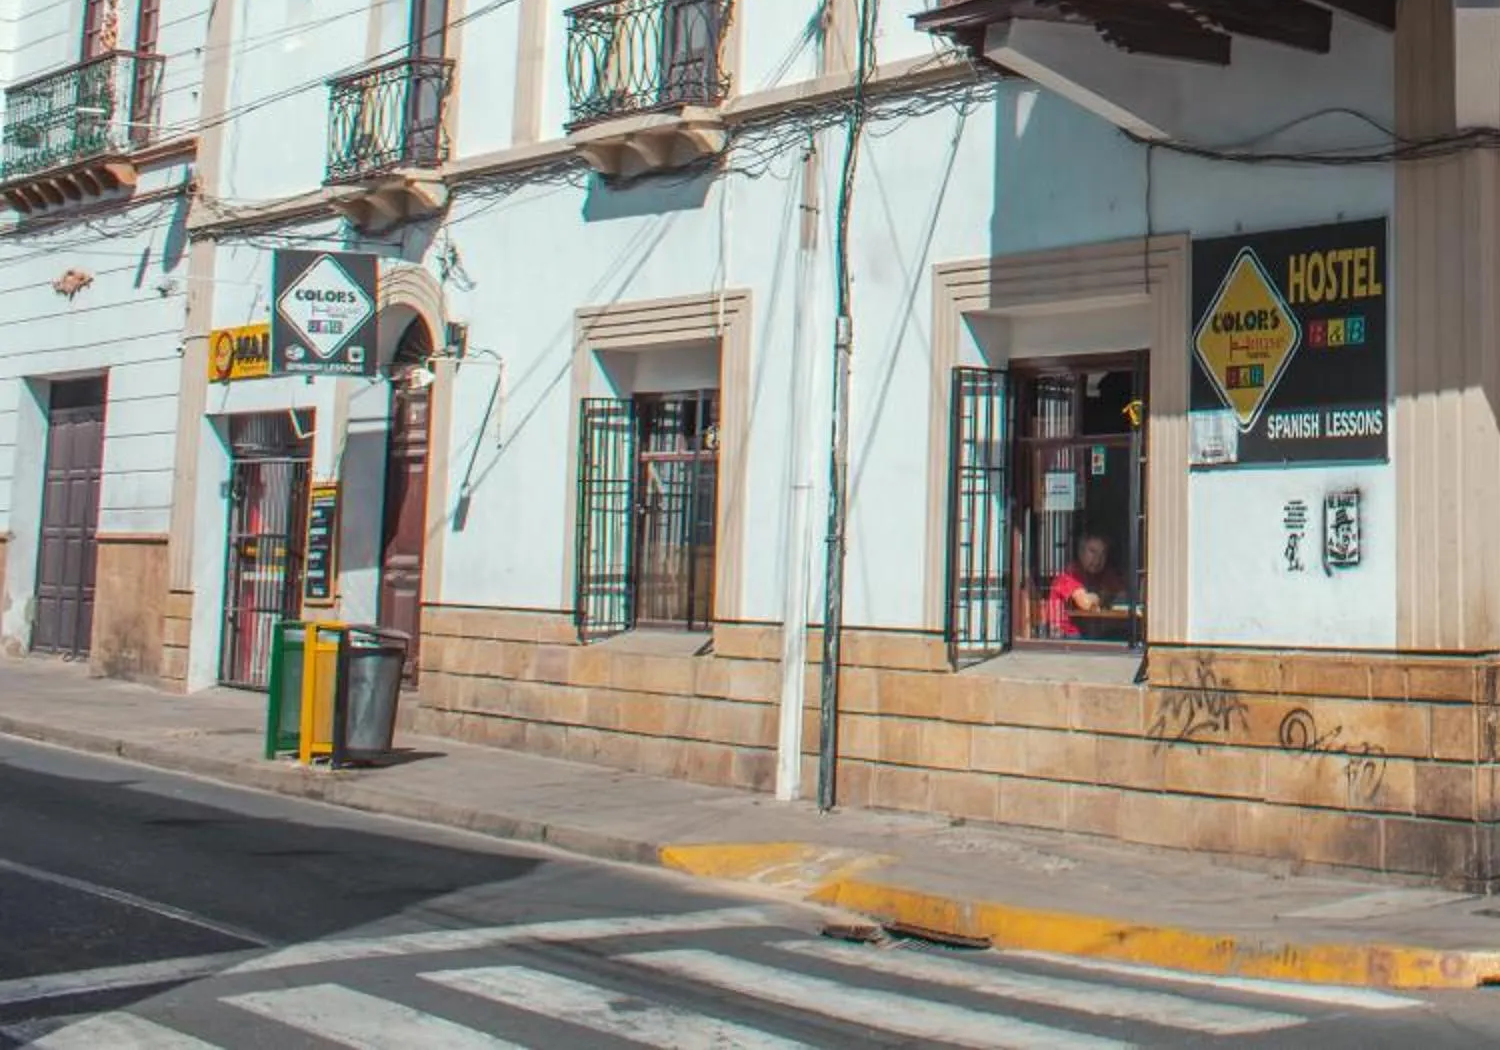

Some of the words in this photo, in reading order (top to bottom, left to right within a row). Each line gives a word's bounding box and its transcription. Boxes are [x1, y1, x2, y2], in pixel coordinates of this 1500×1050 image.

[1288, 246, 1382, 303] HOSTEL
[295, 289, 356, 303] COLORS
[1211, 307, 1281, 334] COLORS
[1267, 414, 1320, 439] SPANISH
[1325, 409, 1384, 437] LESSONS
